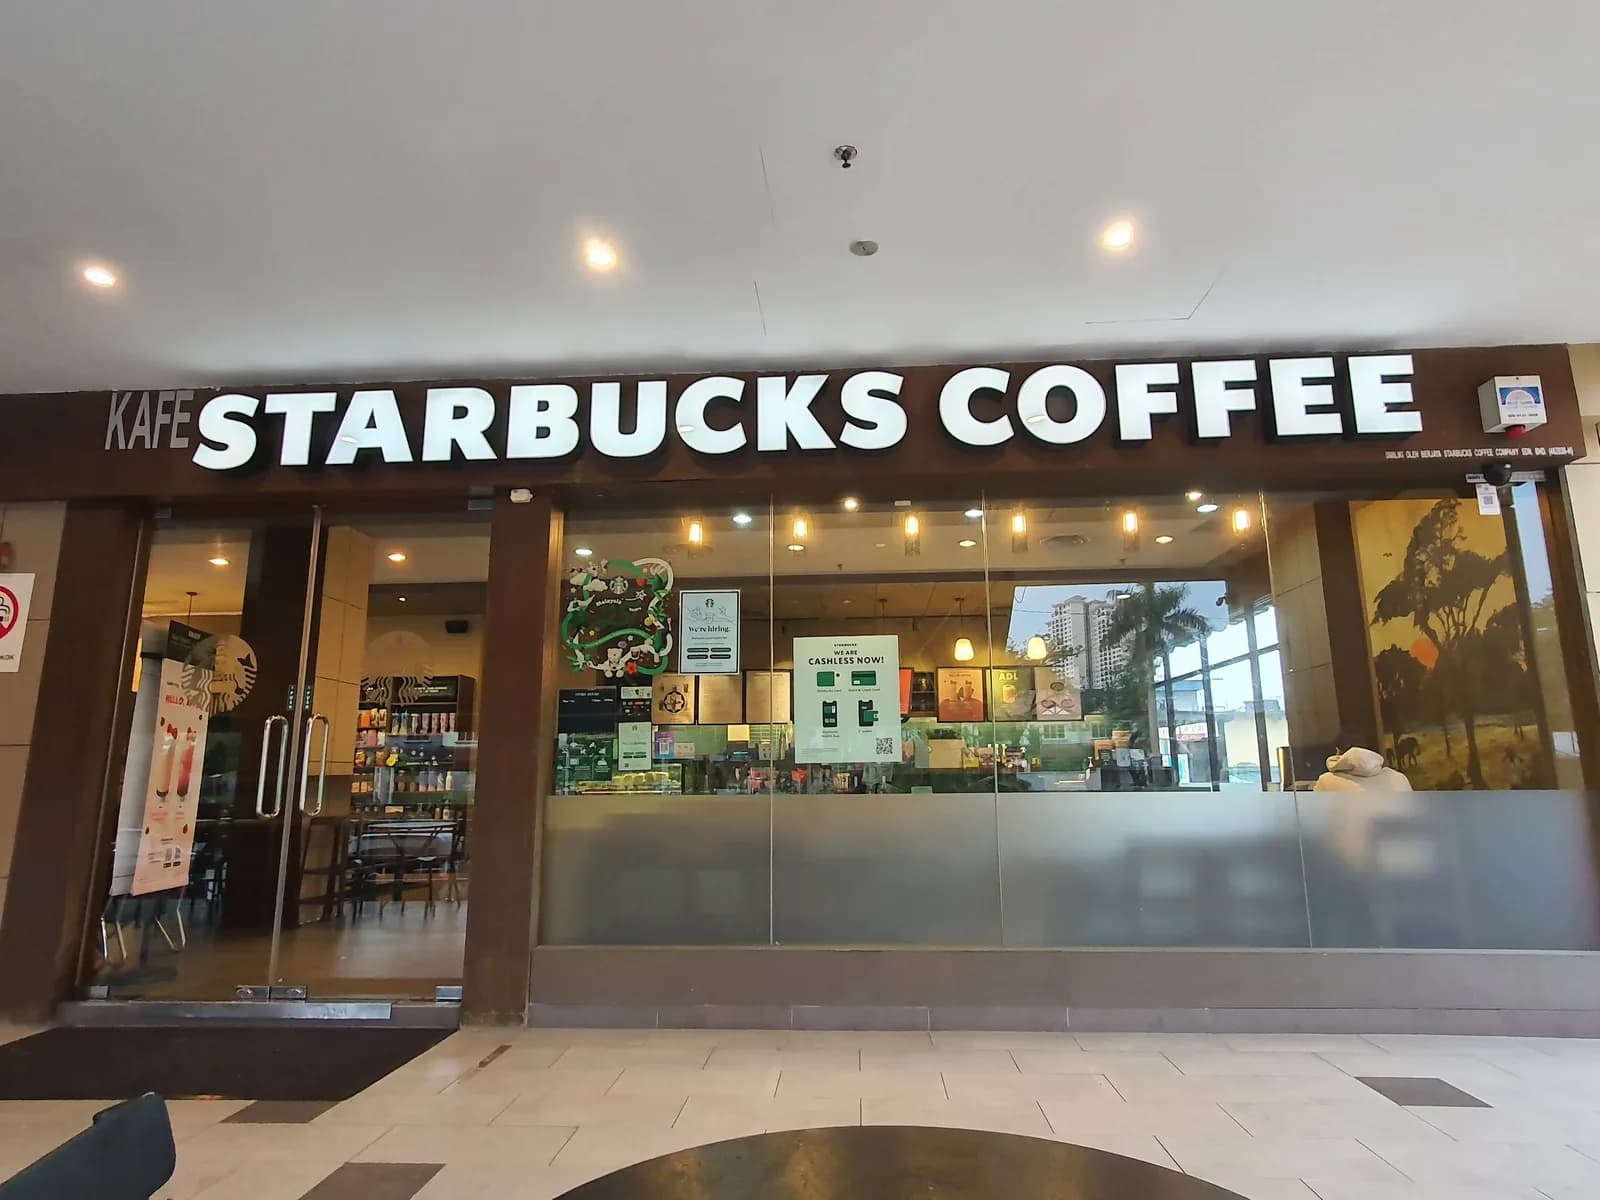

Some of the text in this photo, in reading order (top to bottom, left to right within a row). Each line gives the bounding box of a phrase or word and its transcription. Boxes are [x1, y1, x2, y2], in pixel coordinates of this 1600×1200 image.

[104, 354, 1423, 470] KAFE STARBUCKS COFFEE
[1443, 449, 1473, 458] STARBUCKS
[1473, 448, 1494, 457] COFFEE
[808, 656, 885, 666] CASHLESS NOW!
